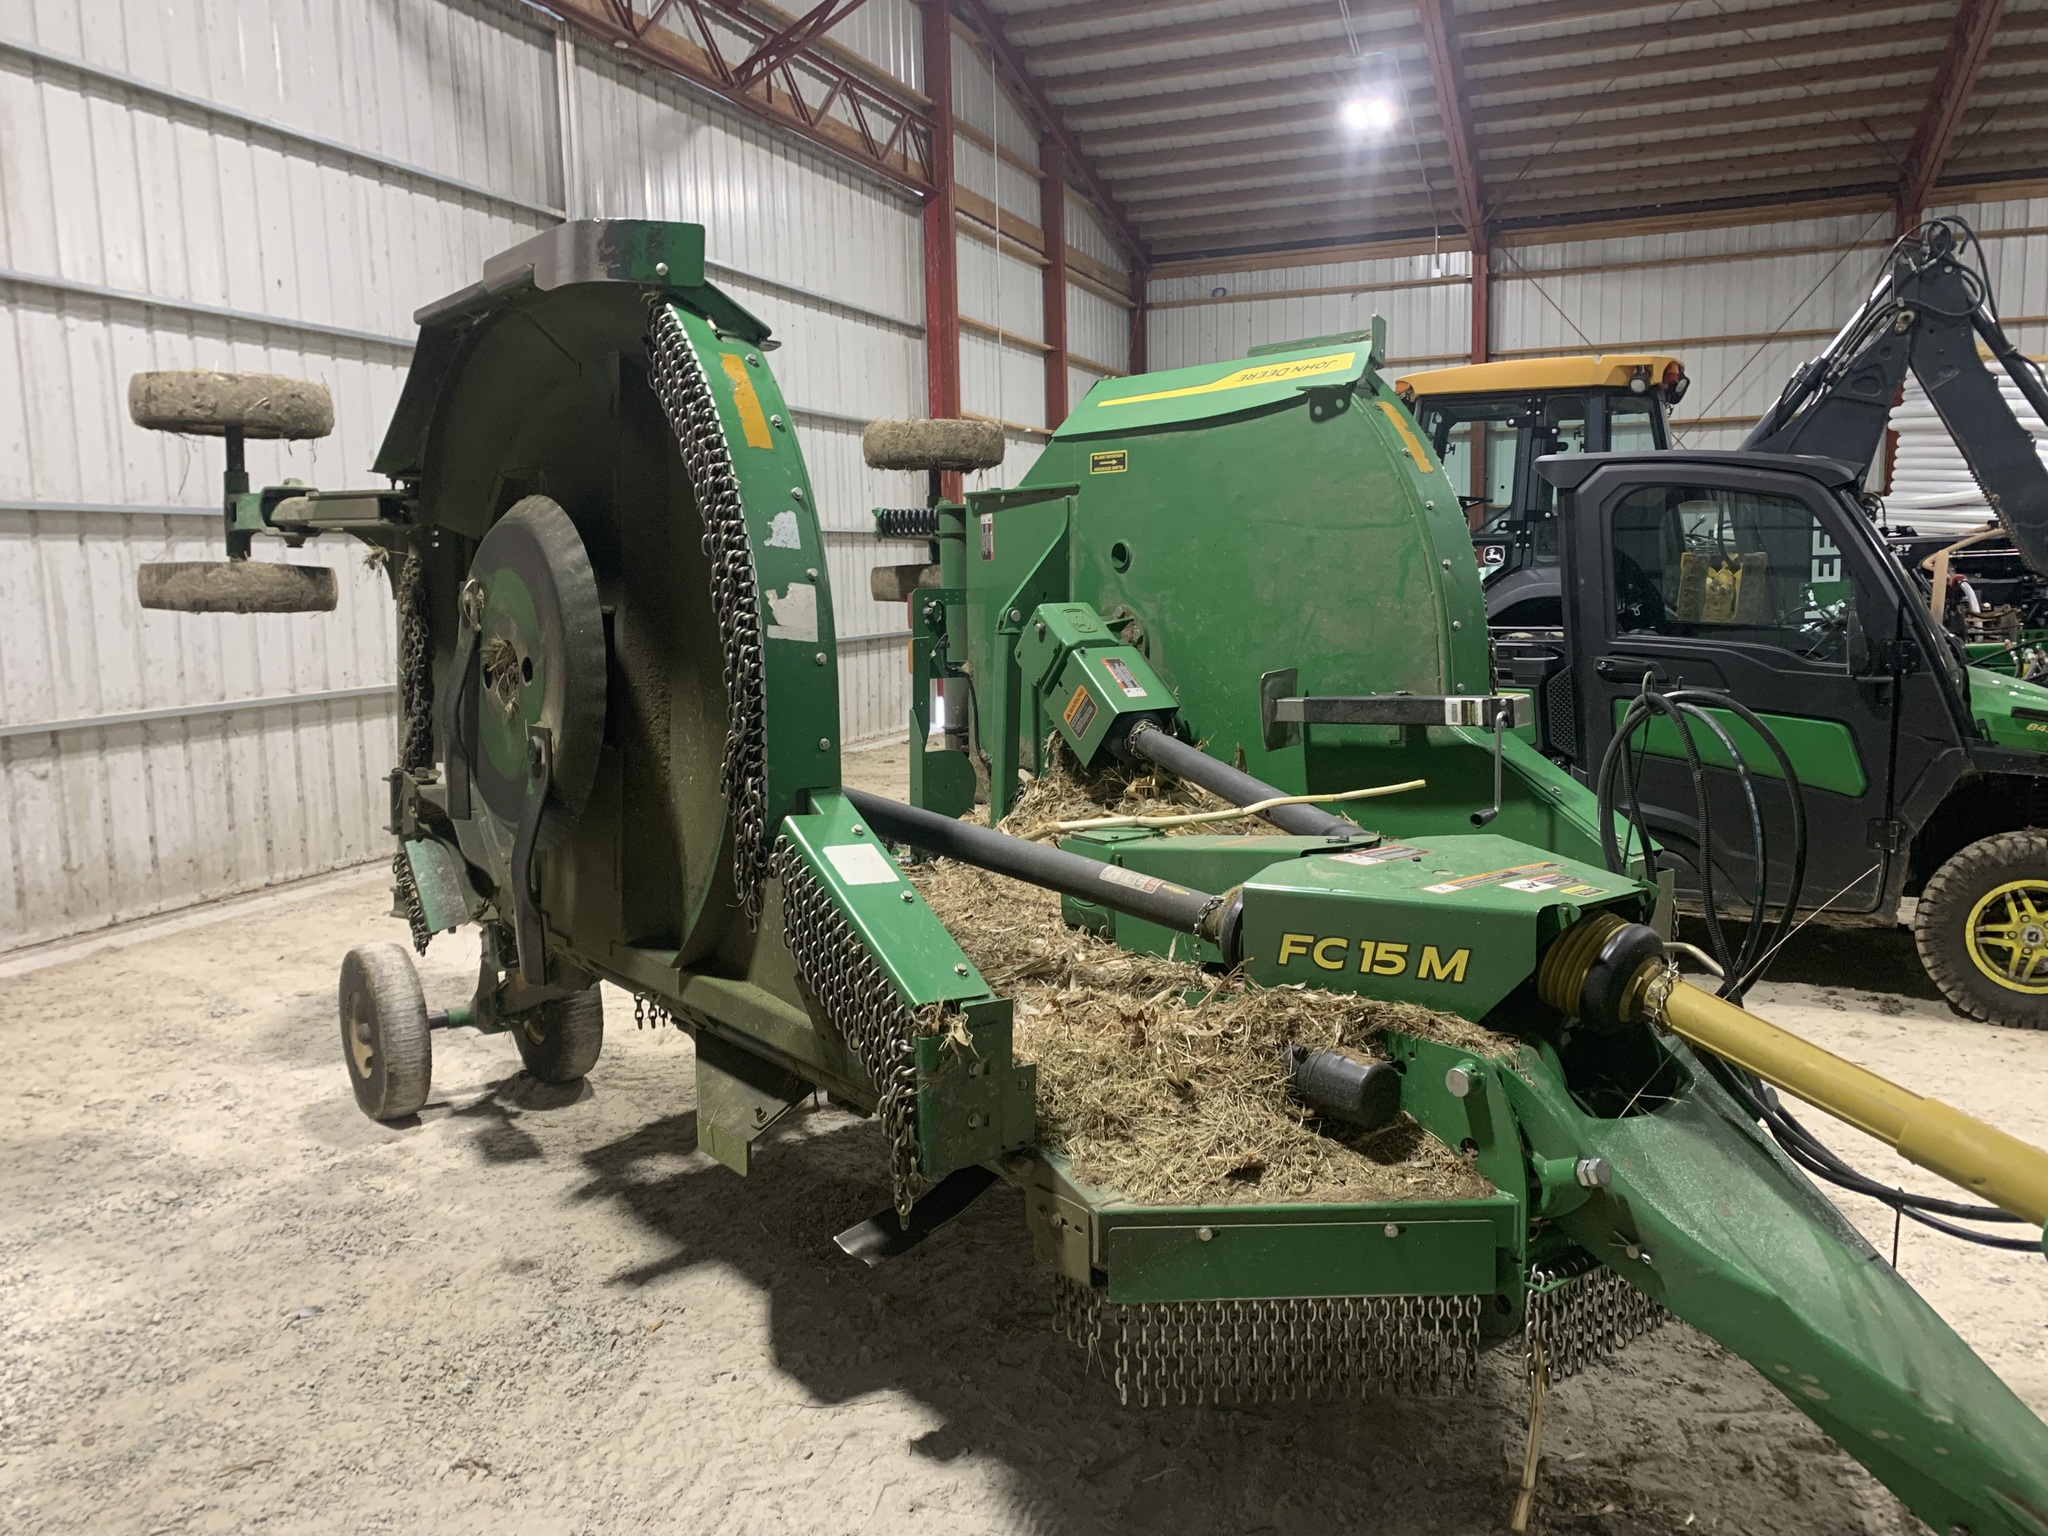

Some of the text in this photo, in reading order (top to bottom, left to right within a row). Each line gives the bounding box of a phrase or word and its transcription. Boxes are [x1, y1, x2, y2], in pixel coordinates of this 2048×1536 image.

[1236, 359, 1338, 382] JOHN DEERE
[1279, 932, 1470, 982] FC 15 M
